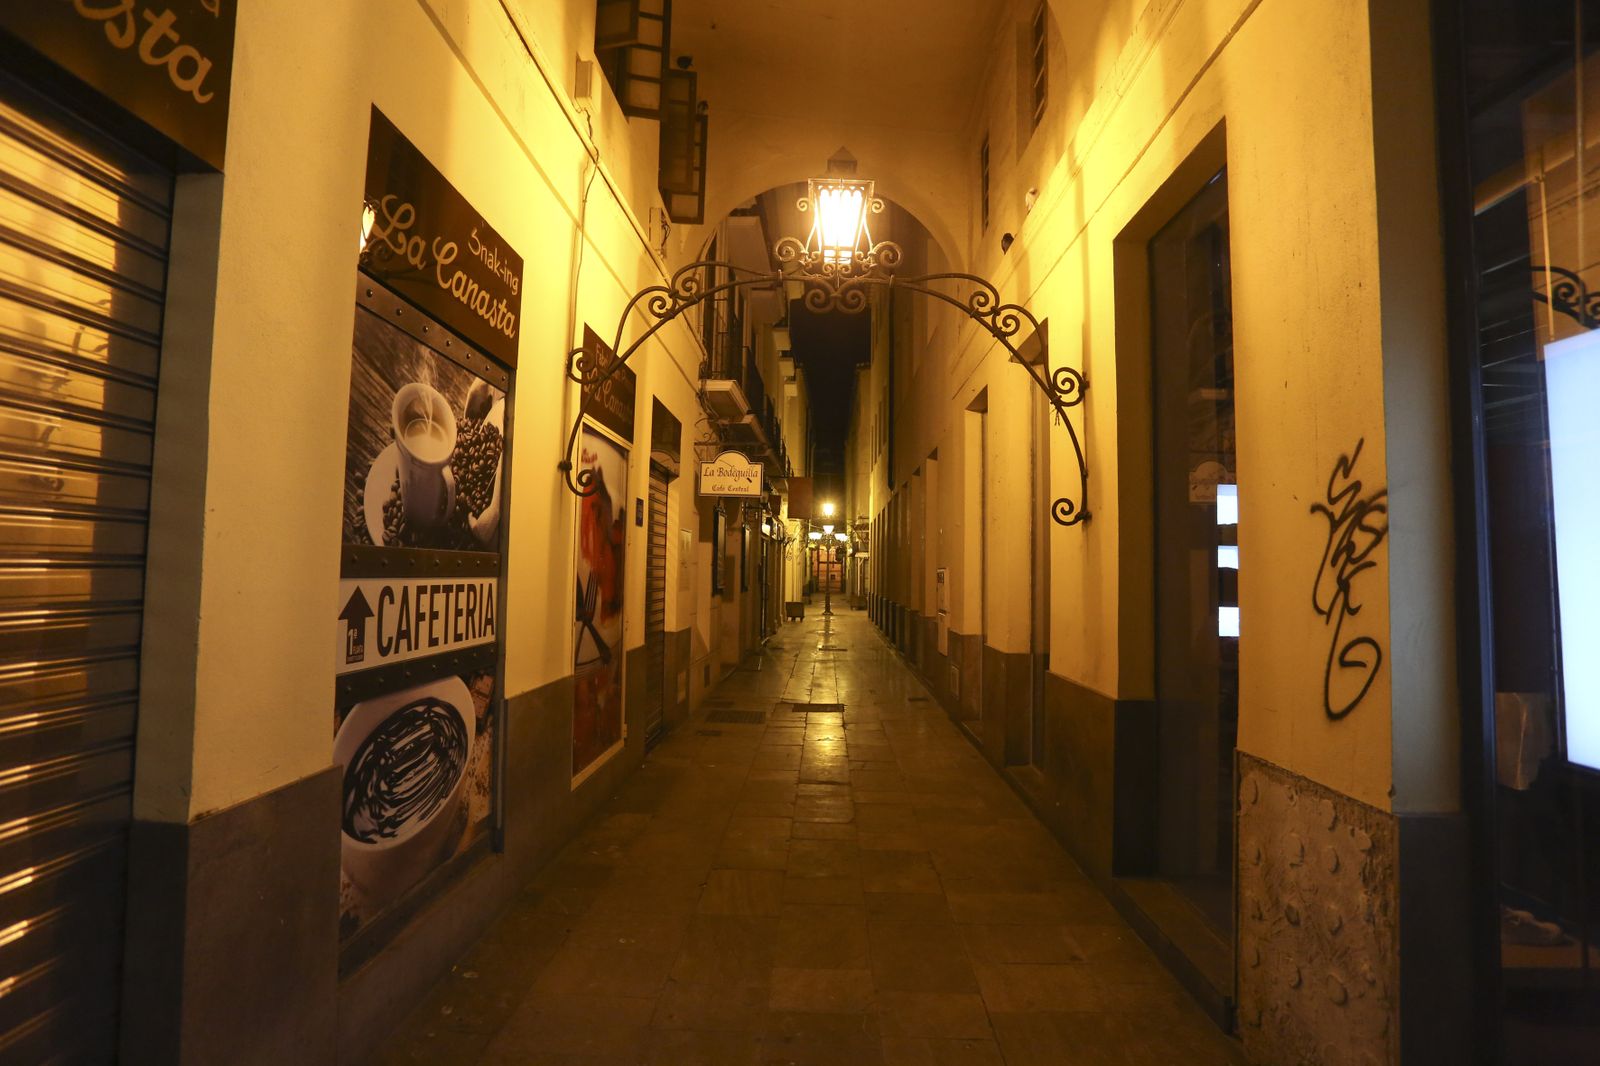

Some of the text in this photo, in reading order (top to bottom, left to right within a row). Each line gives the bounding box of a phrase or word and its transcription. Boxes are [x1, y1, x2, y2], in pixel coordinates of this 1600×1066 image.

[371, 194, 516, 339] La Canasta
[703, 463, 759, 482] La Bodeguilla
[376, 582, 495, 658] CAFETERIA
